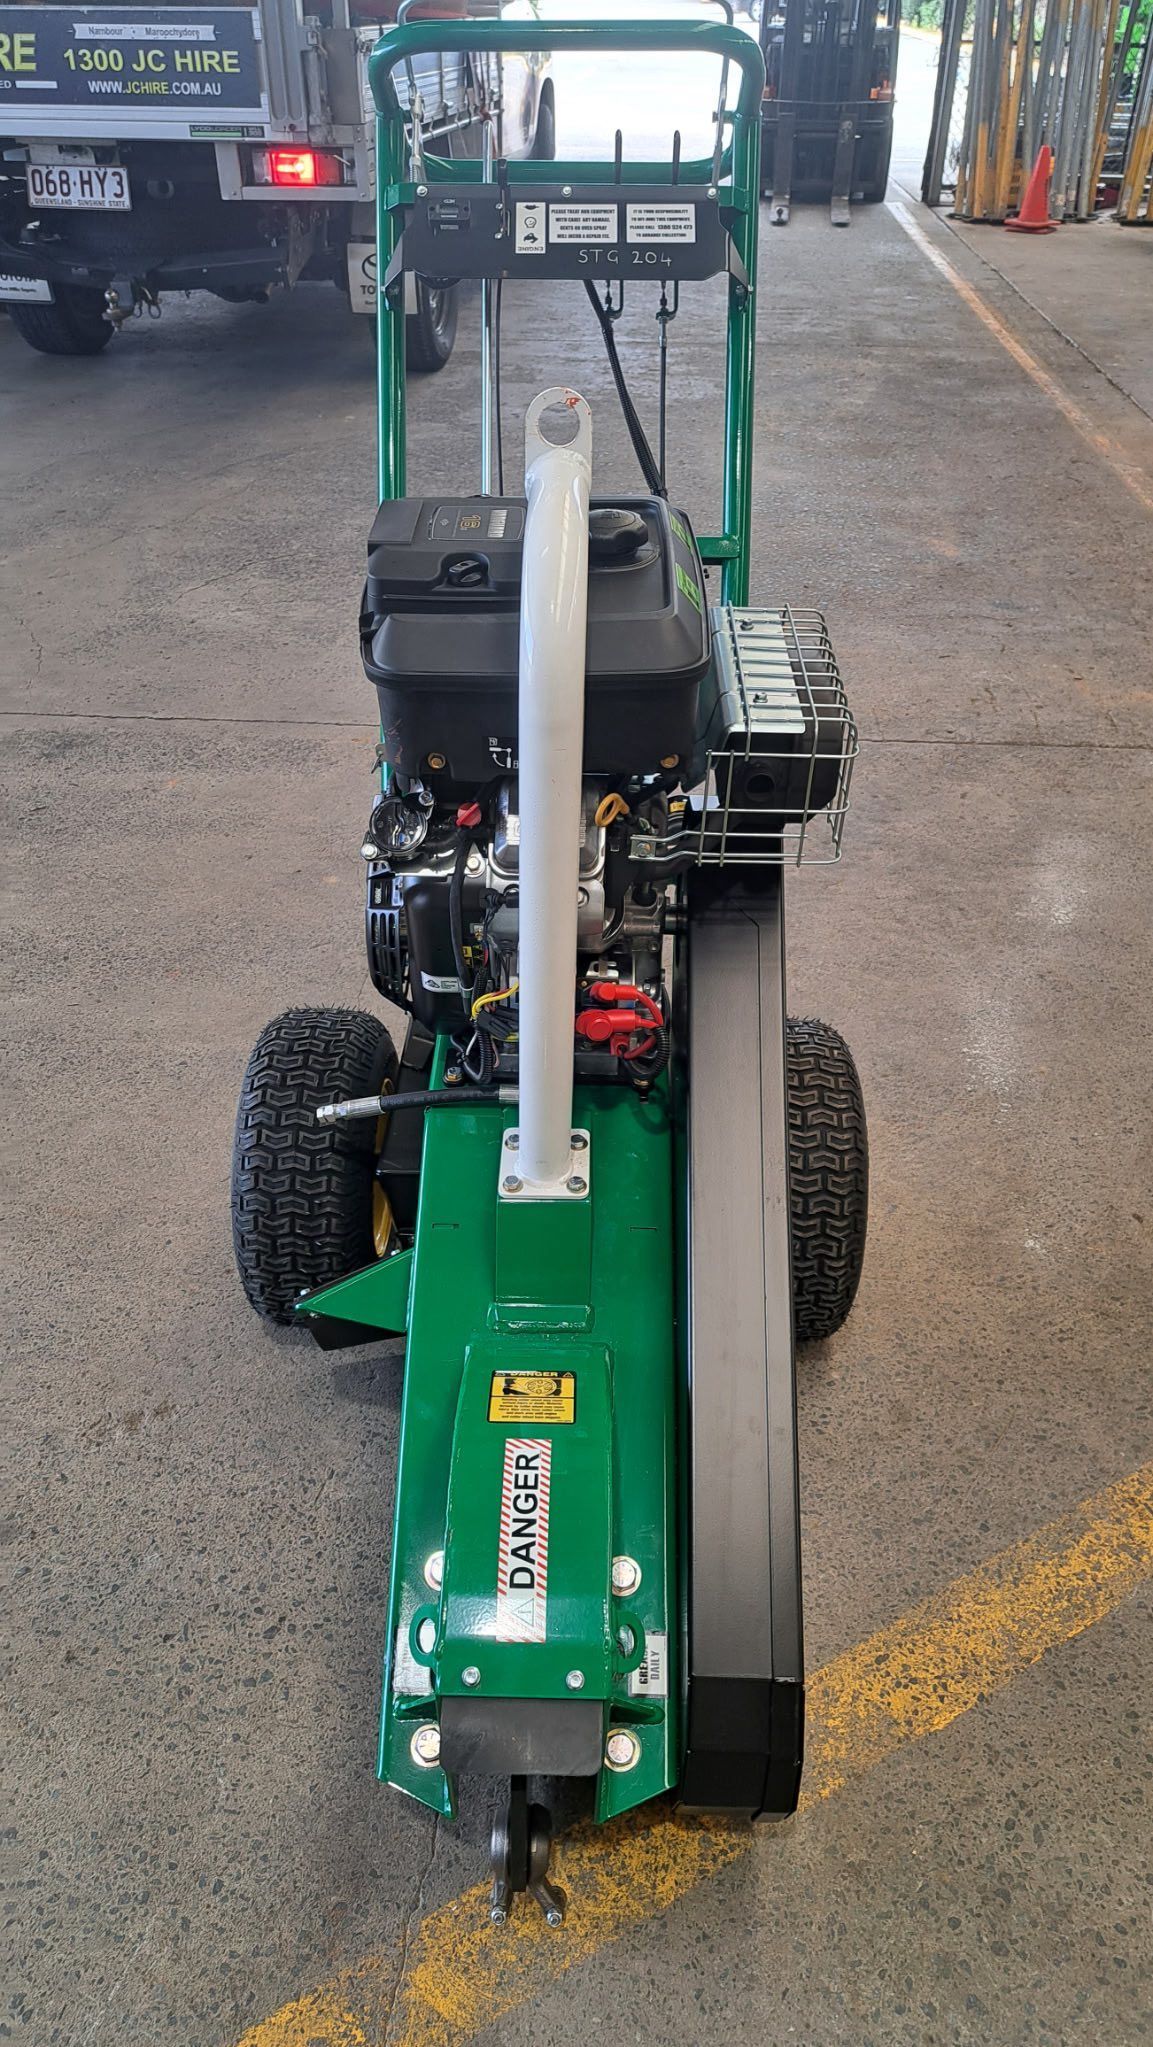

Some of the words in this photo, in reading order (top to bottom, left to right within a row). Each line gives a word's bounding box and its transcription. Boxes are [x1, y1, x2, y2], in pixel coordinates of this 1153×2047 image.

[63, 48, 124, 72] 1300
[131, 49, 166, 73] JC
[175, 50, 241, 73] HIRE
[88, 80, 222, 96] WWW.JCHIRE.COM.AU
[631, 250, 672, 267] 204
[509, 1451, 541, 1590] DANGER
[650, 1650, 660, 1680] DAILY
